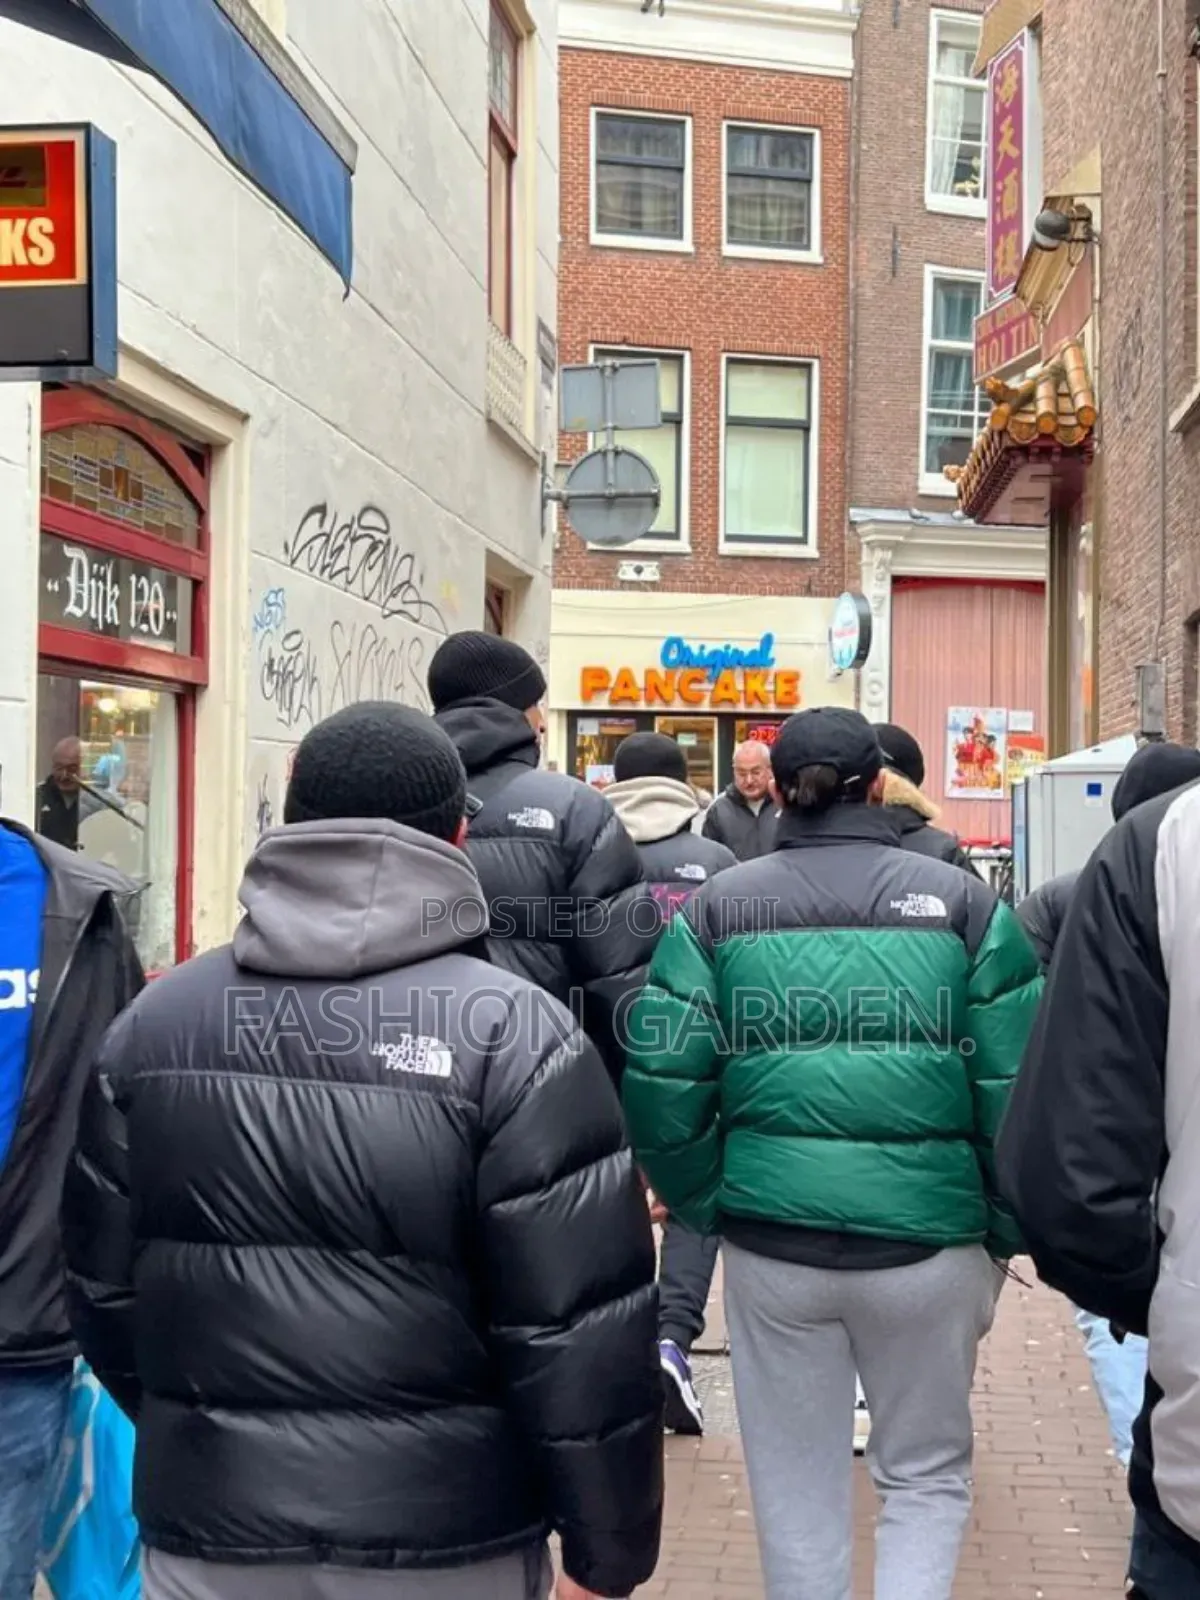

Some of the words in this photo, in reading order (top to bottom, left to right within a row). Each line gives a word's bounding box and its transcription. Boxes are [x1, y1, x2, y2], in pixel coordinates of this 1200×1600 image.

[129, 573, 165, 635] 120
[661, 633, 775, 682] Original
[581, 667, 800, 704] PANCAKE
[372, 1041, 428, 1062] NORTH
[400, 1032, 431, 1050] THE
[385, 1057, 427, 1073] FACE
